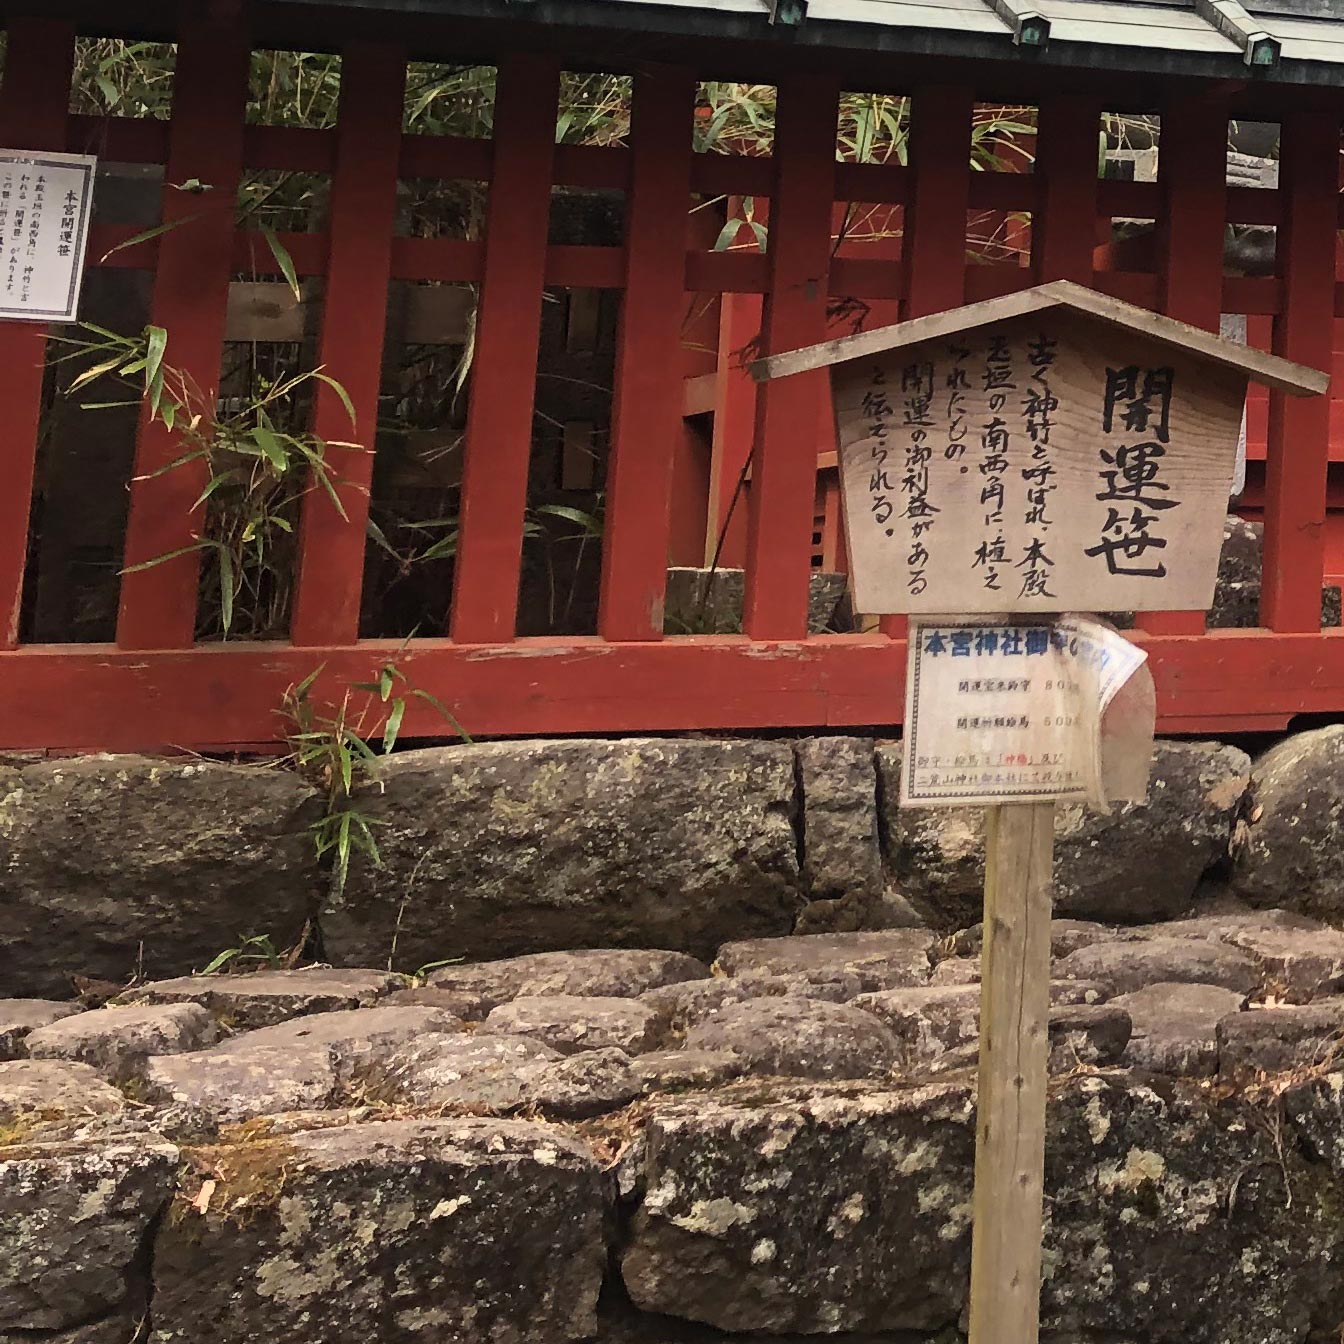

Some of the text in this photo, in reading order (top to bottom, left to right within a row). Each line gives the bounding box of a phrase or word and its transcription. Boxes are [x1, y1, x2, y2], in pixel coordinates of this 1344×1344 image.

[57, 189, 79, 257] 本宮開運笹
[861, 366, 894, 538] と伝えられる。
[899, 361, 942, 596] 開運の御利益がある
[1014, 332, 1058, 599] 古く神竹と呼ばれ、本殿
[1084, 365, 1182, 577] 開運笹
